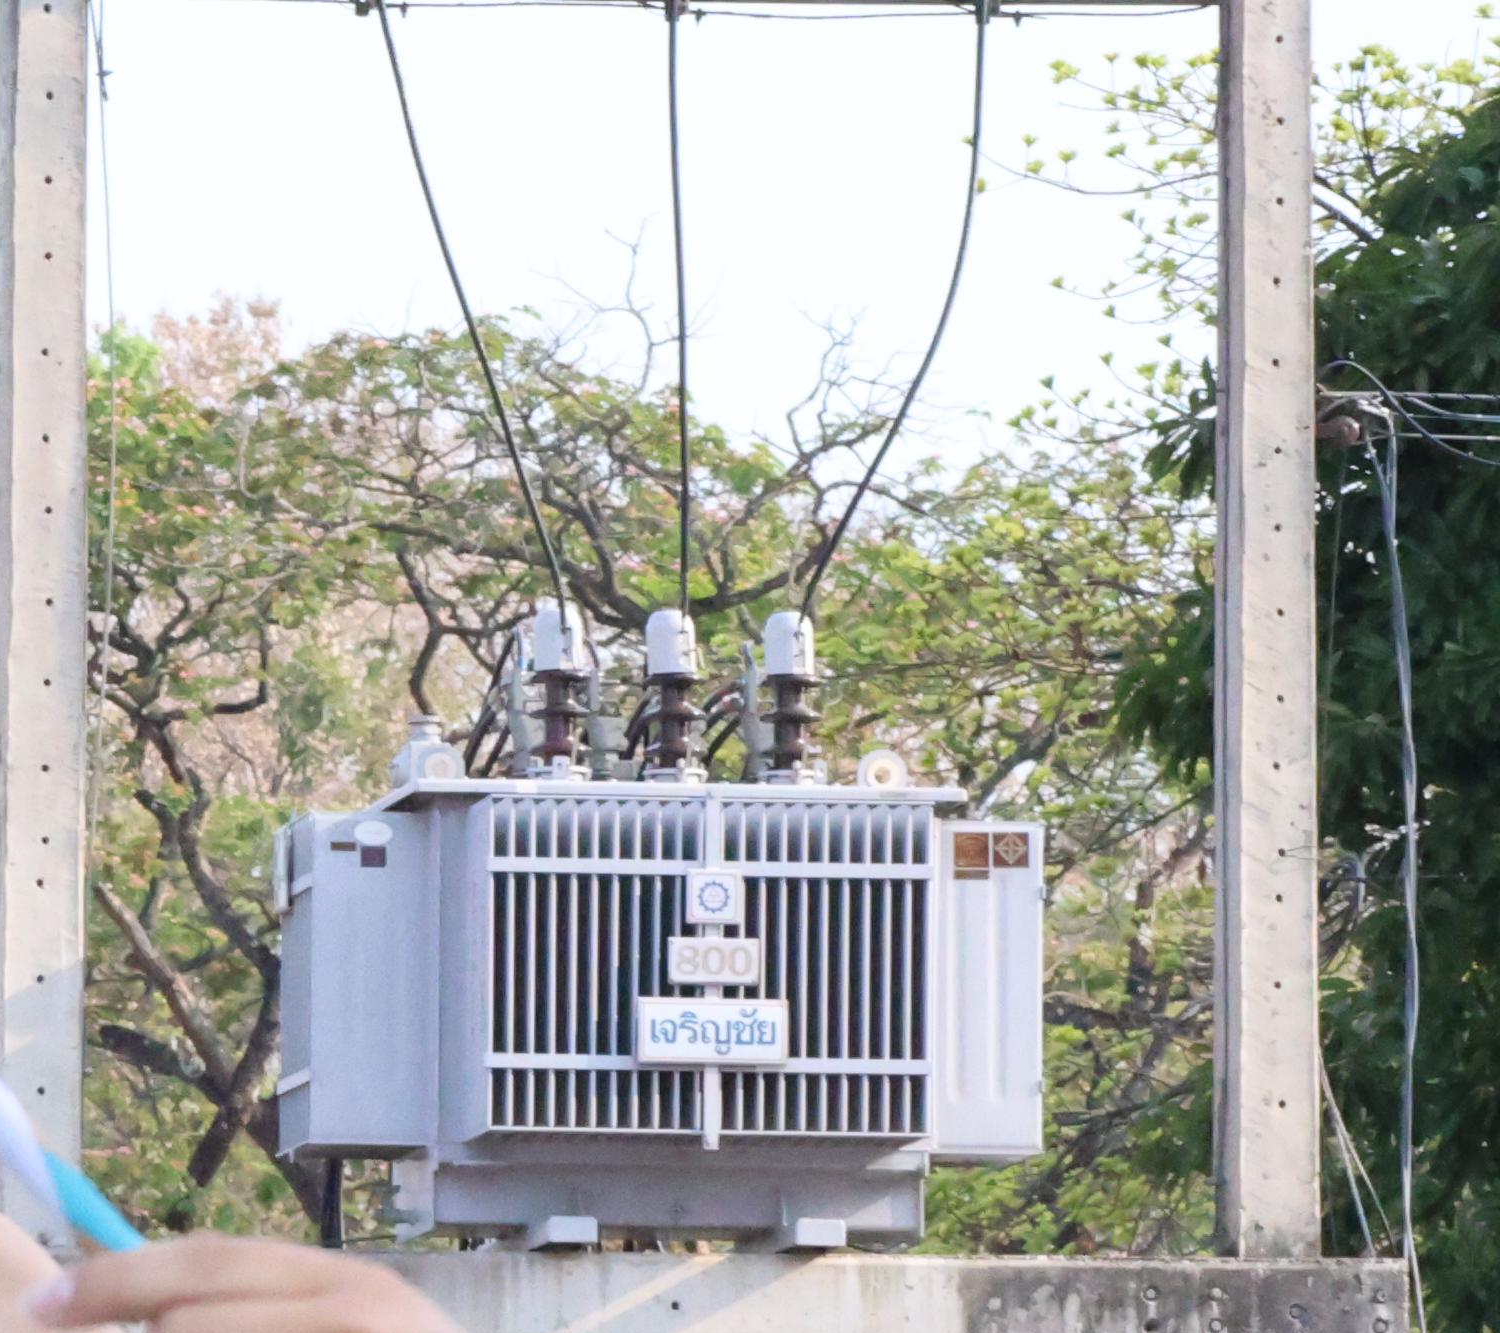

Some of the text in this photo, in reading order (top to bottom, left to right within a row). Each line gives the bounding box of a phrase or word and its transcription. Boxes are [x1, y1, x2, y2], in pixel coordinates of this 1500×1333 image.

[676, 945, 753, 977] 800
[651, 1007, 777, 1056] เจริญชัย
